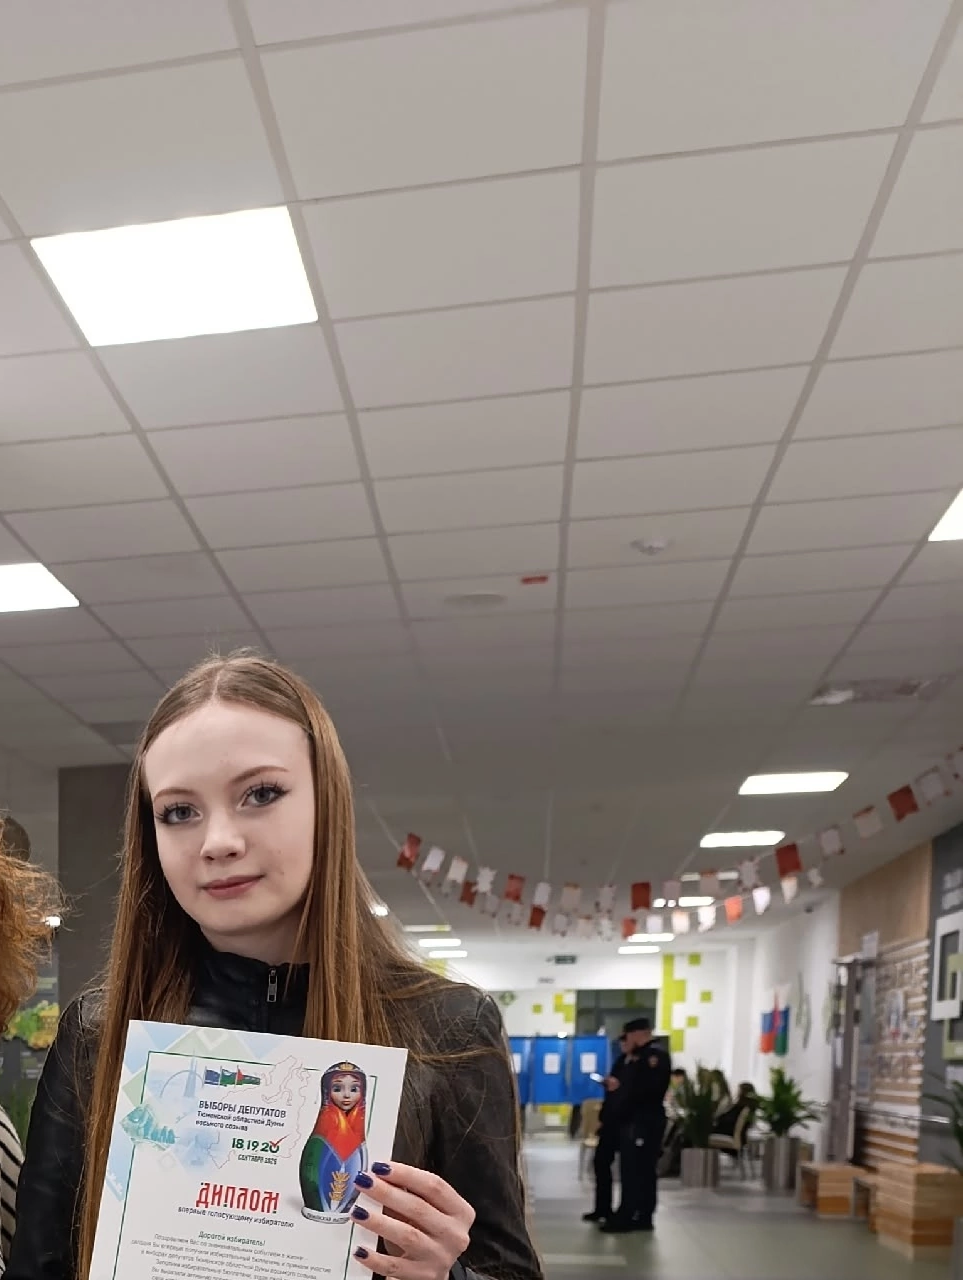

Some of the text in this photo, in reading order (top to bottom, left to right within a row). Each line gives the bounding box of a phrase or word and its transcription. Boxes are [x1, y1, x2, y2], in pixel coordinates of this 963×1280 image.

[198, 1111, 231, 1120] Тюменской
[232, 1116, 264, 1124] областной
[199, 1101, 286, 1118] ВЫБОРЫ ДЕПУТАТОВ
[196, 1182, 279, 1214] ДИПЛОМ
[178, 1206, 294, 1228] впервые голосующему избирателю
[199, 1231, 225, 1240] Дорогой
